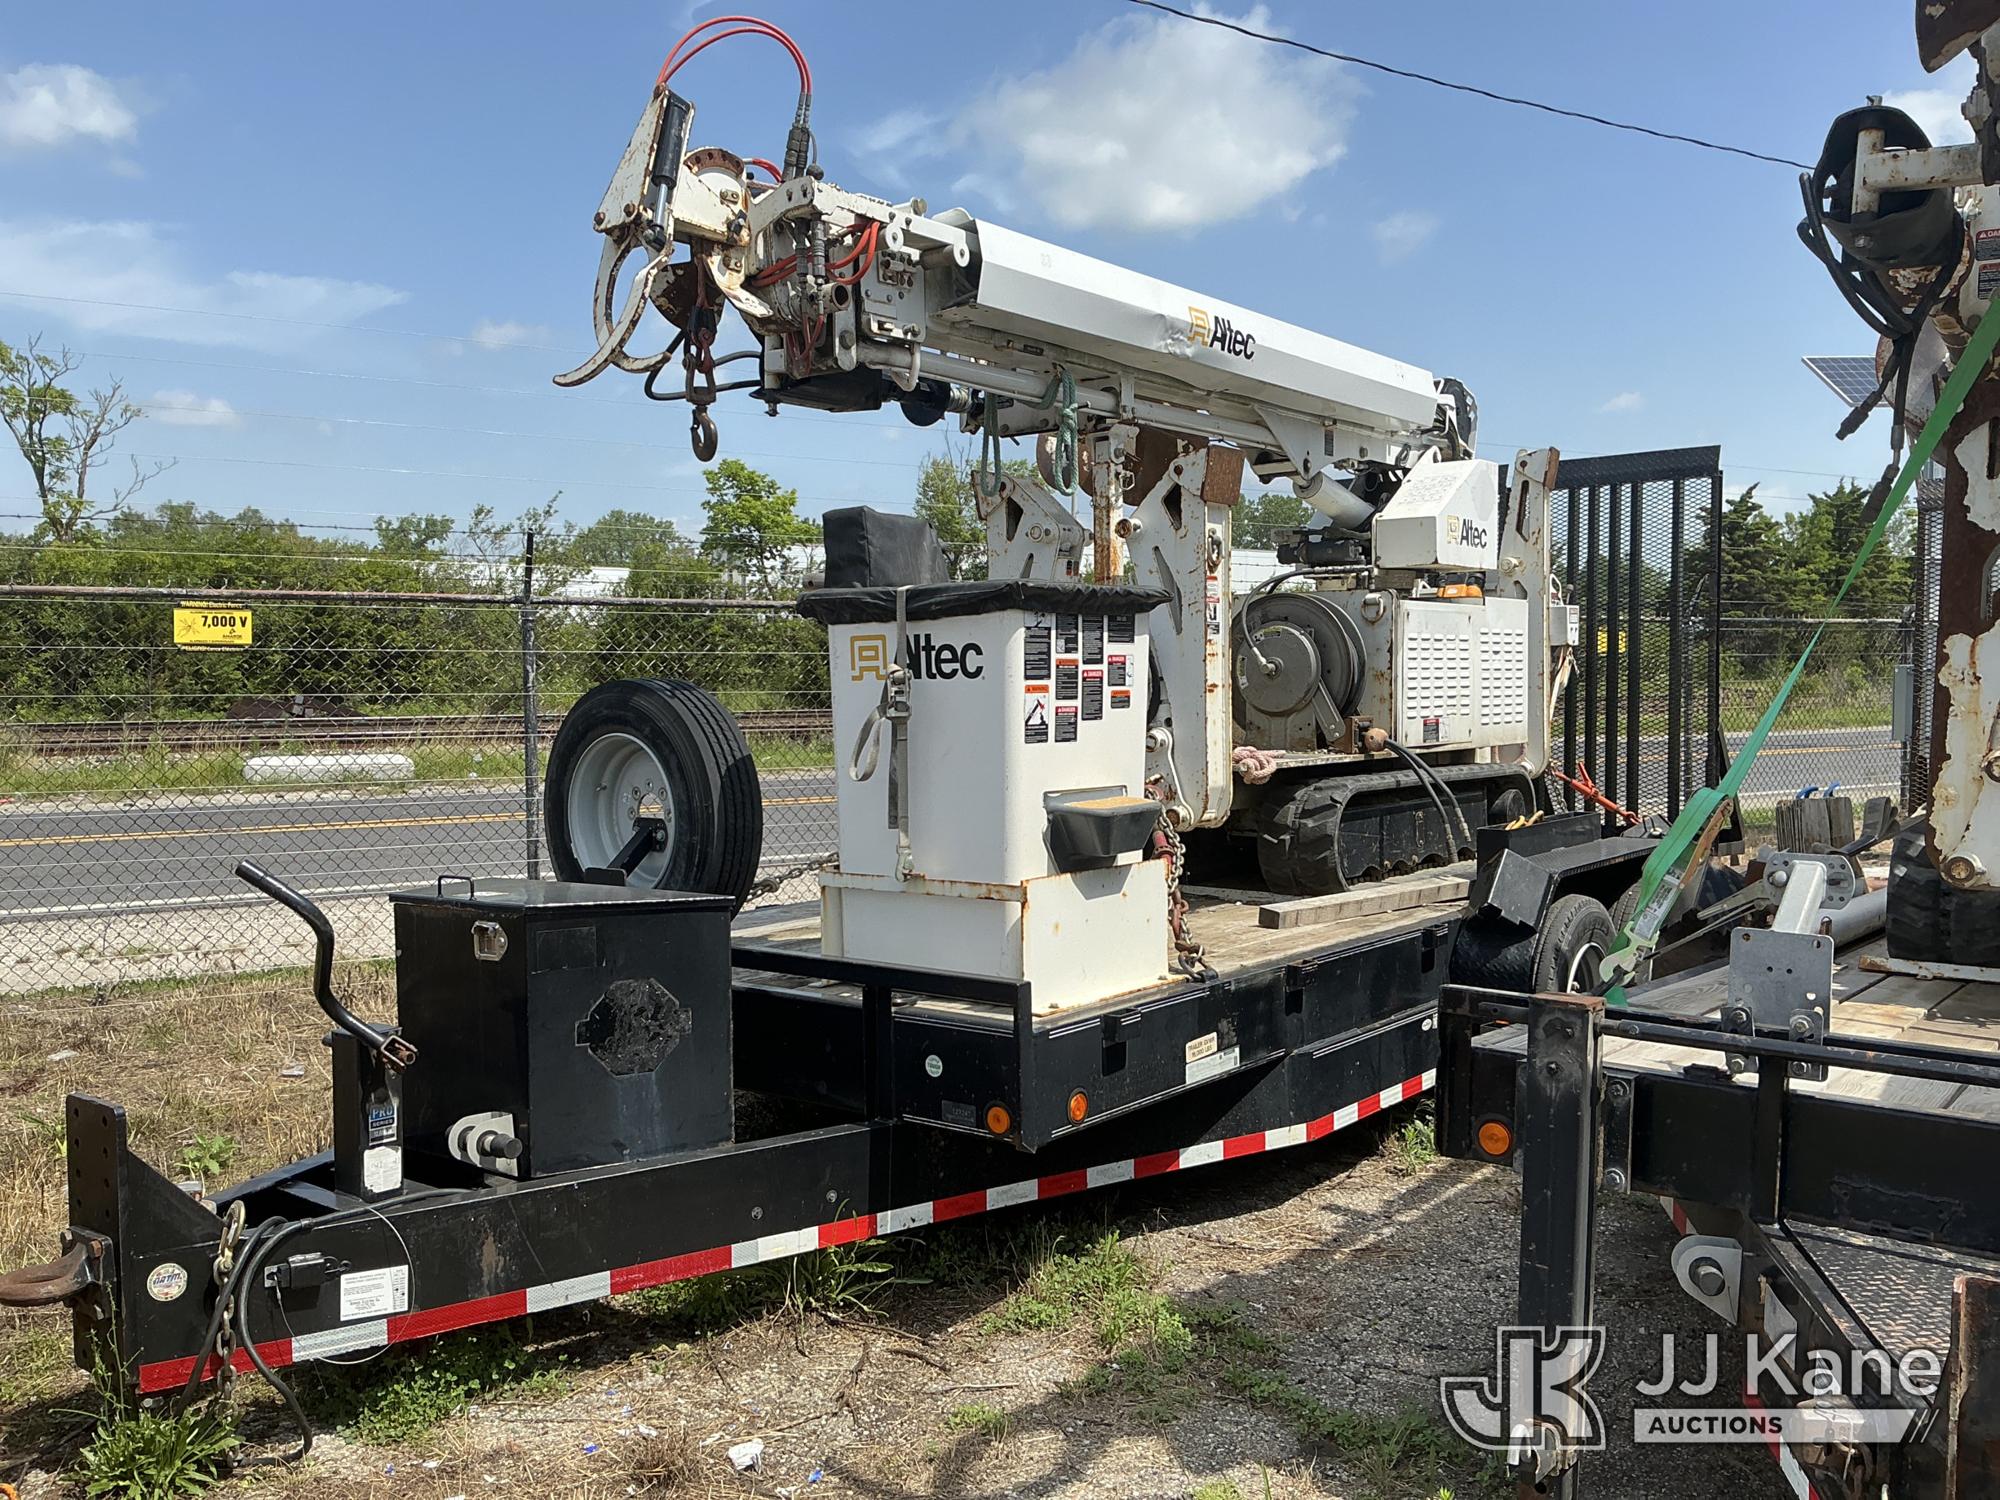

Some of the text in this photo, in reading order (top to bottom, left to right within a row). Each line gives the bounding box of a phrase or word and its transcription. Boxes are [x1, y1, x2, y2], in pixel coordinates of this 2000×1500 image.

[1209, 315, 1256, 360] Altec
[1460, 518, 1487, 549] Altec
[201, 615, 248, 628] 7,000 V
[372, 1105, 393, 1119] PRO
